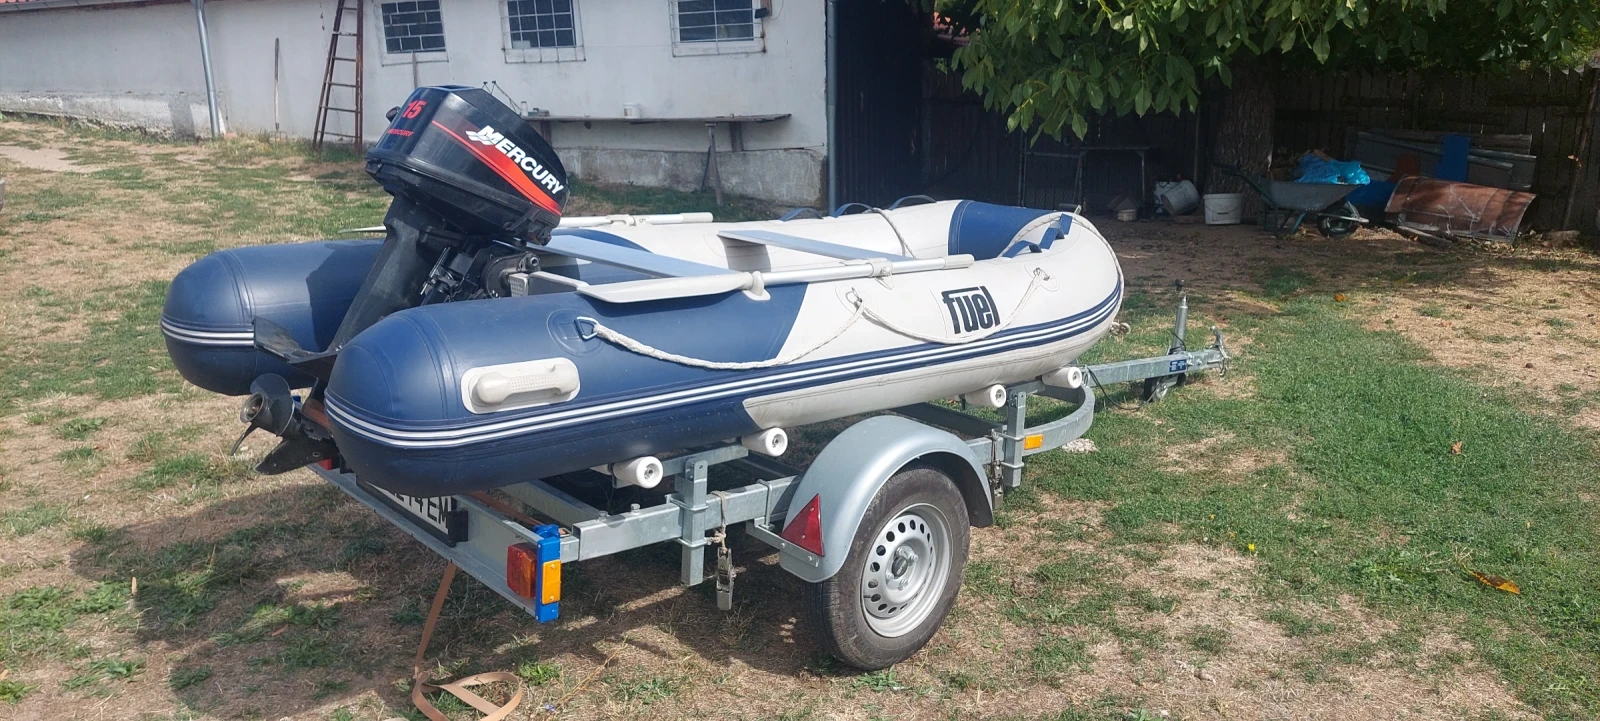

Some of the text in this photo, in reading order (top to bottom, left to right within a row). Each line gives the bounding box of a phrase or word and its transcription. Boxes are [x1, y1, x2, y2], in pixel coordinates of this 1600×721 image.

[402, 100, 427, 119] 15
[475, 125, 564, 194] MERCURY
[941, 285, 1001, 334] fuel
